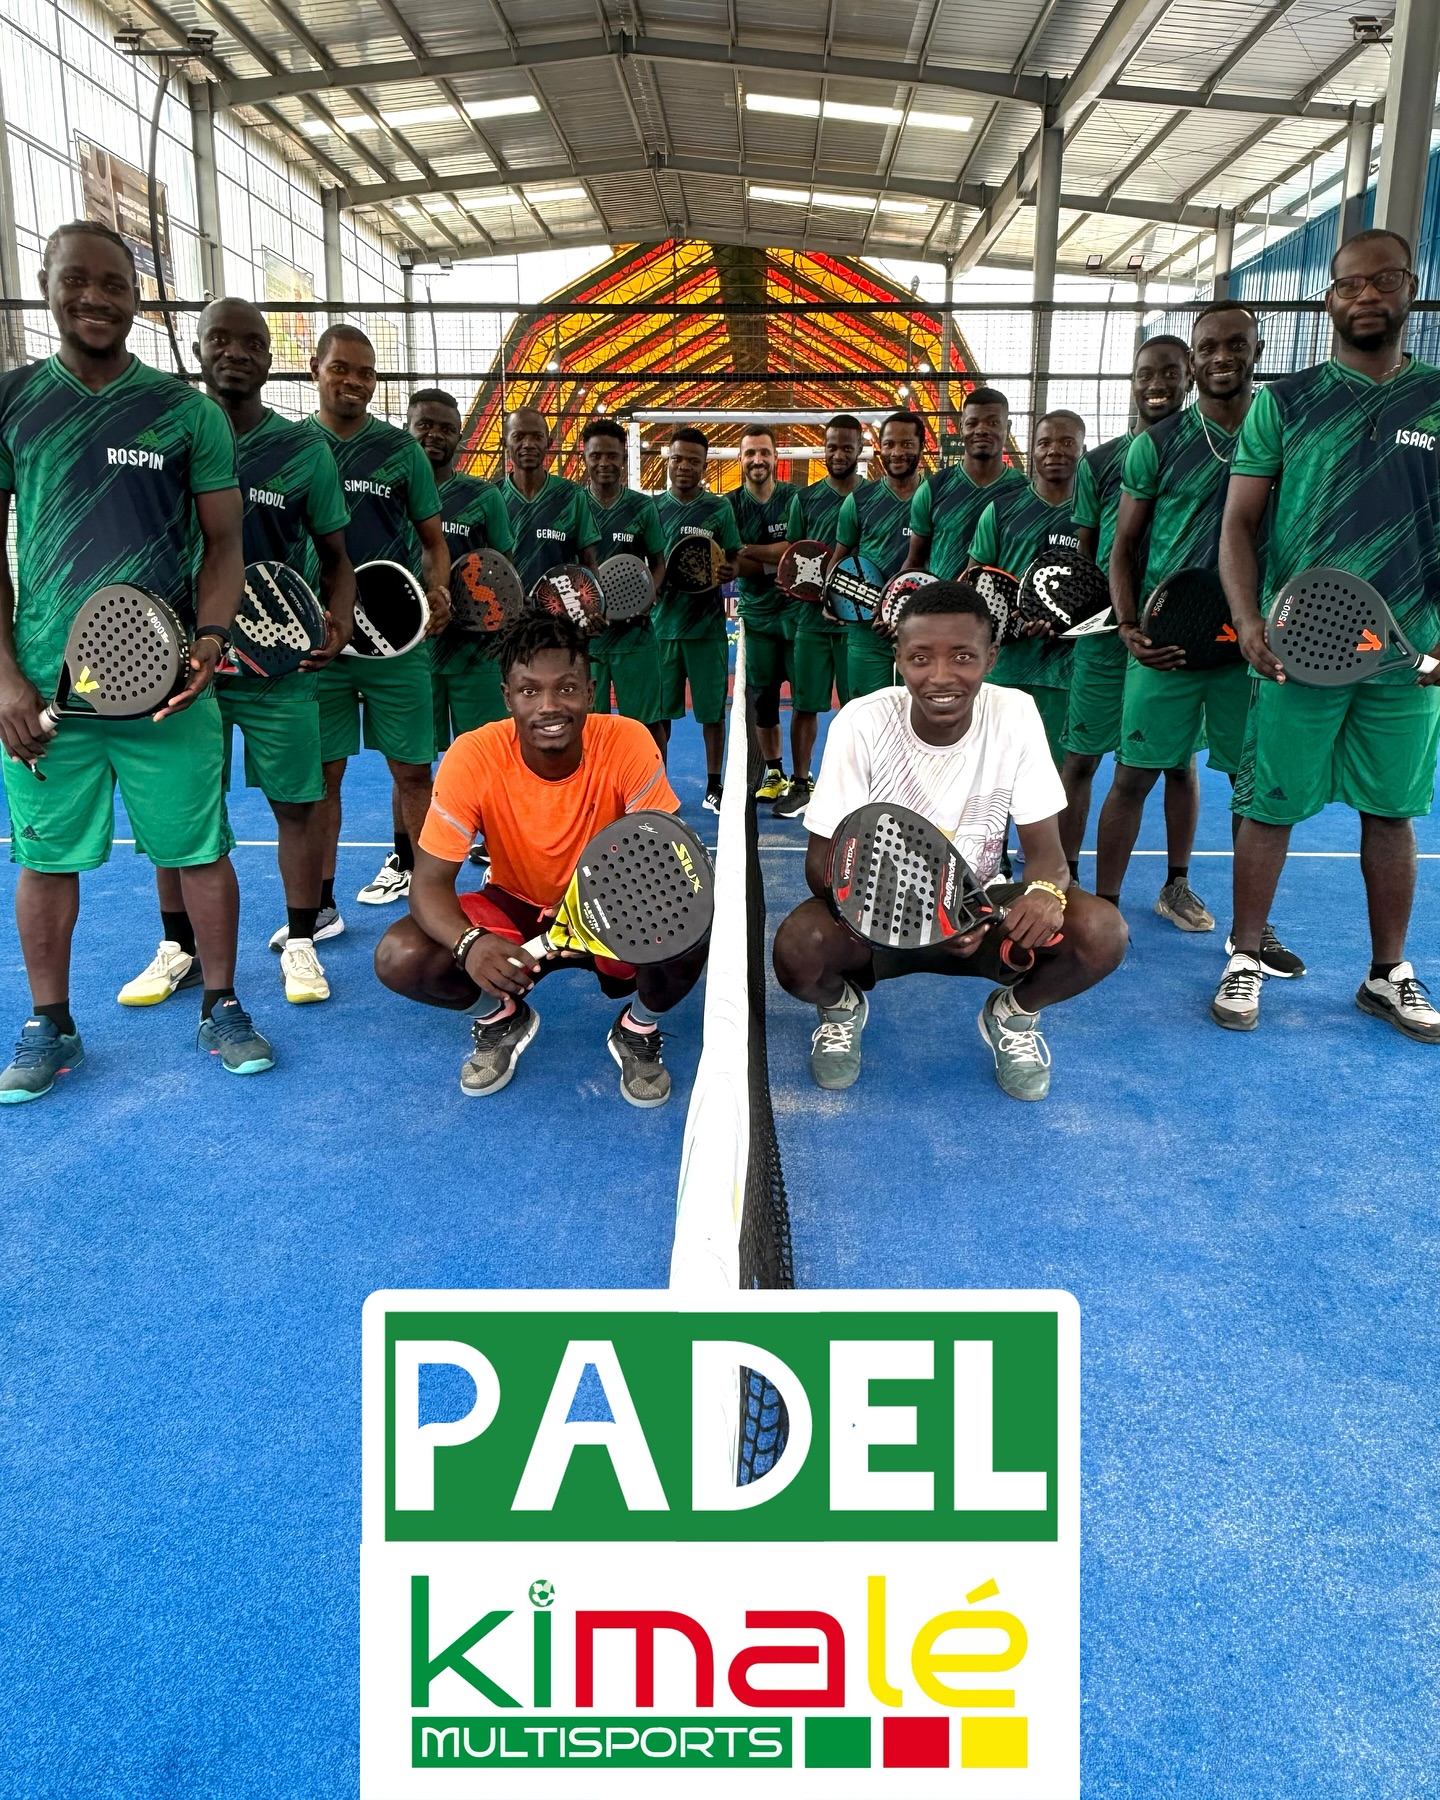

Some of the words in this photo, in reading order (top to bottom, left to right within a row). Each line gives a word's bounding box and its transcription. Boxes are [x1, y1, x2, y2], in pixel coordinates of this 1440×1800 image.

[1395, 429, 1436, 451] ISAAC
[106, 447, 164, 471] ROSPIN
[249, 487, 286, 510] RAOUL
[344, 479, 391, 499] SIMPLICE
[146, 607, 165, 634] V800
[1276, 604, 1291, 627] V500
[671, 840, 703, 893] SIUX
